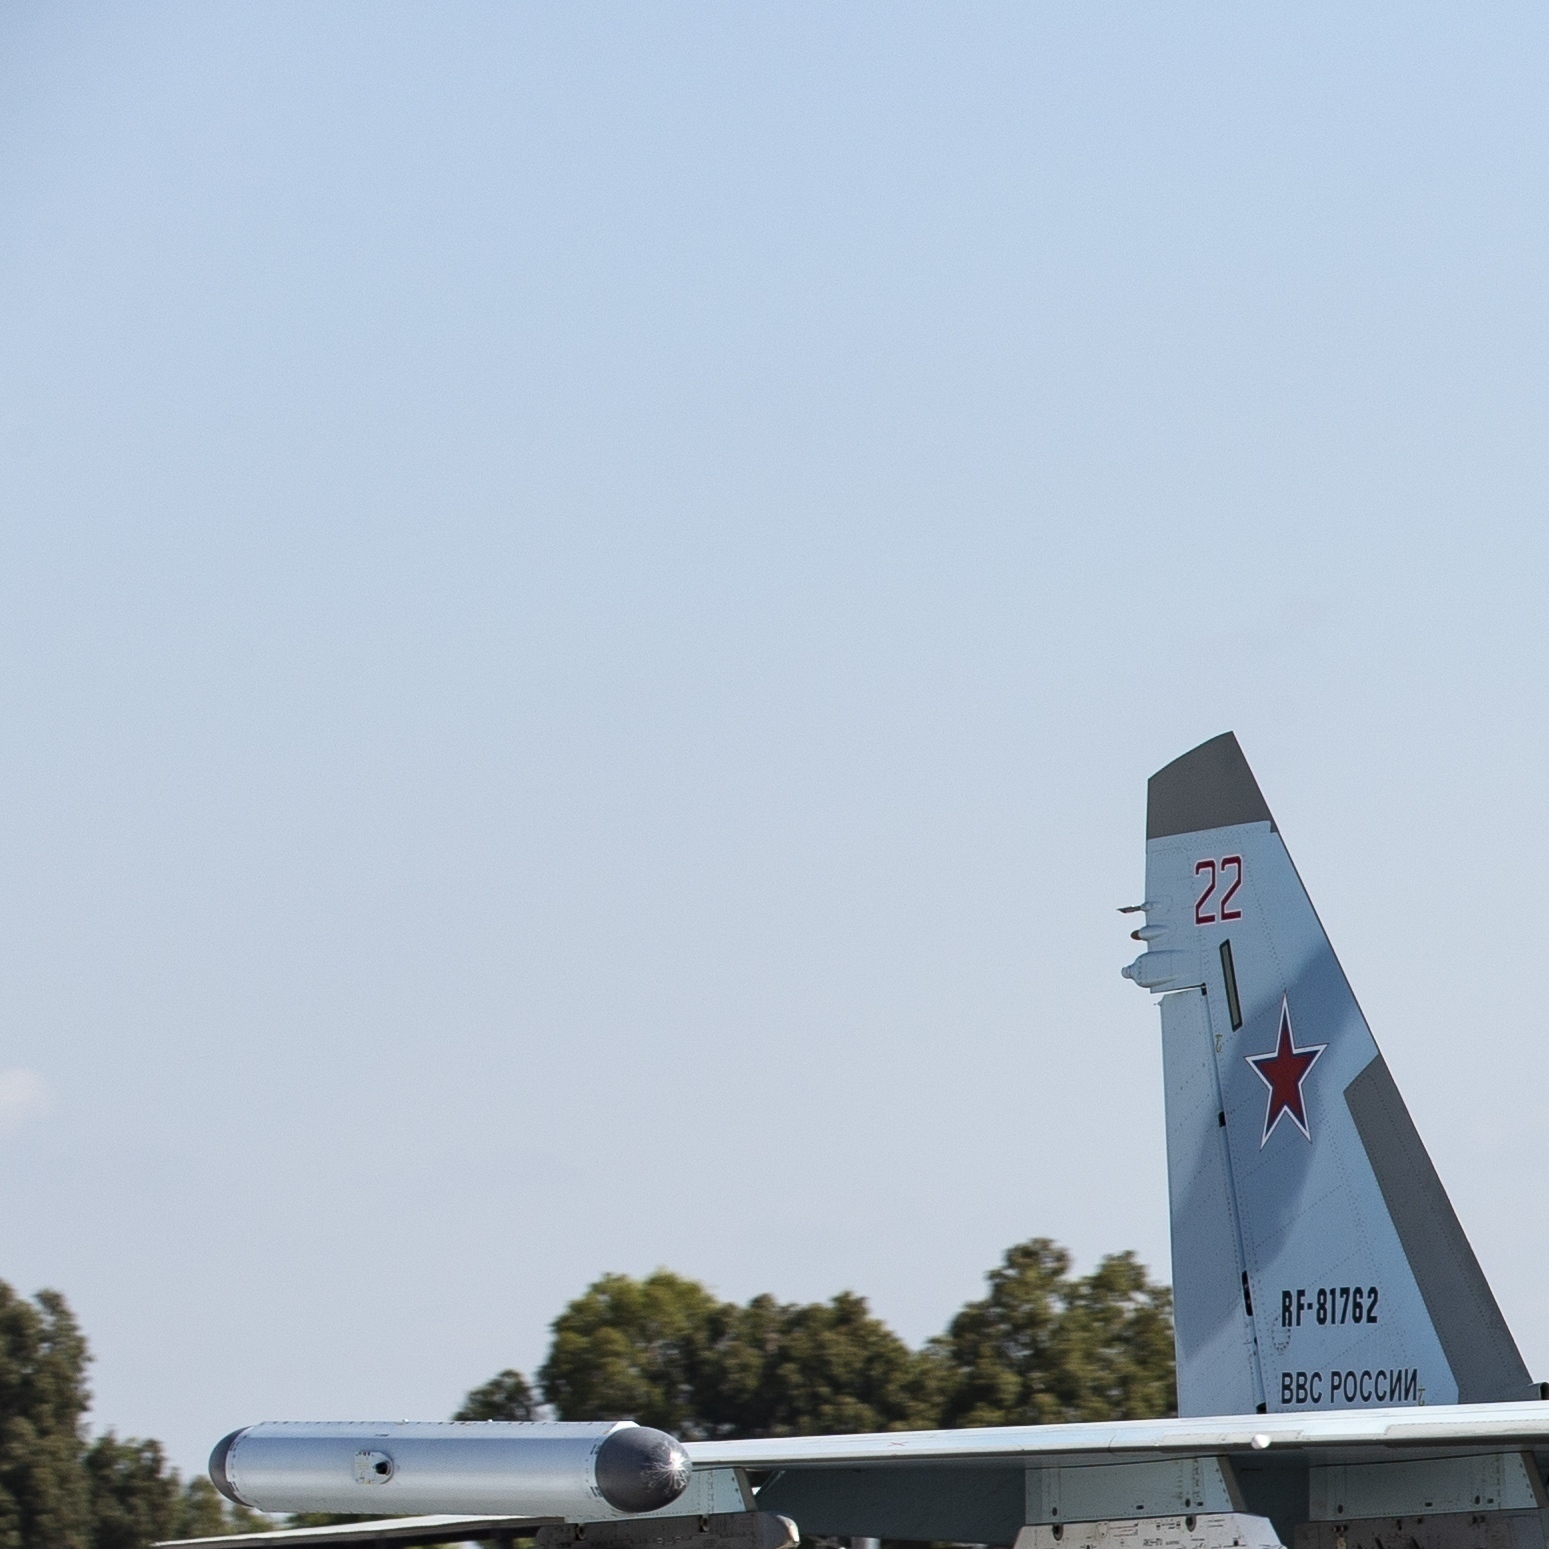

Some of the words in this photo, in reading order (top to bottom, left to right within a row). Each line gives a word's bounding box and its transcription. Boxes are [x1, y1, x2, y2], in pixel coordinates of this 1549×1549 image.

[1195, 855, 1243, 925] 22
[1281, 1286, 1380, 1328] RF-81762
[1281, 1371, 1323, 1405] ВВС
[1330, 1368, 1418, 1404] РОССИИ
